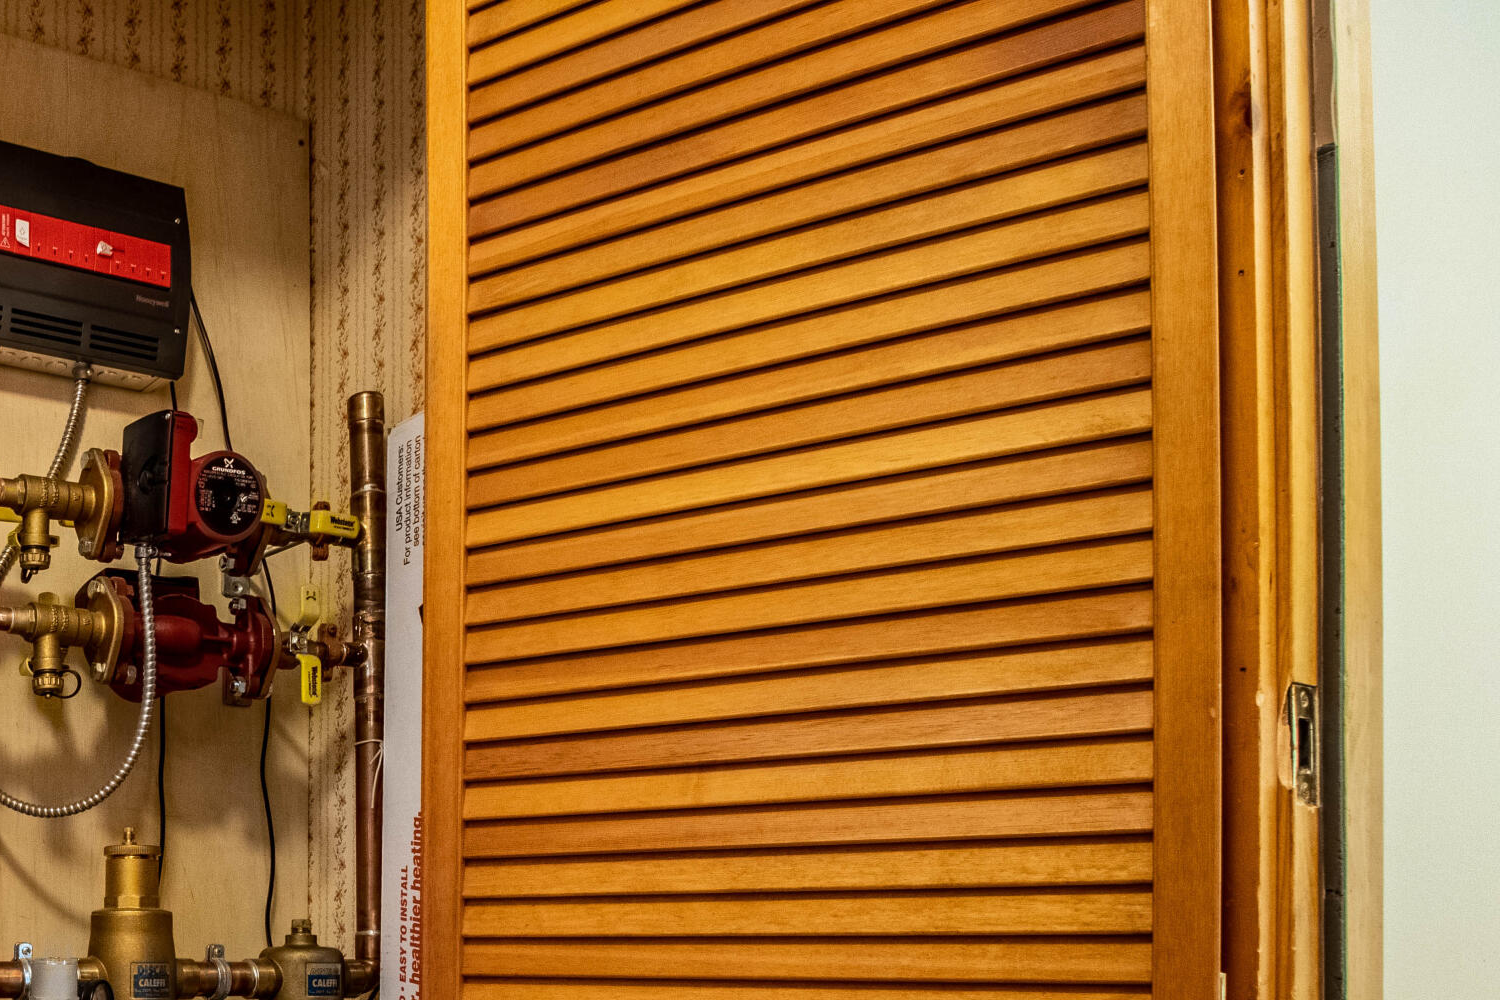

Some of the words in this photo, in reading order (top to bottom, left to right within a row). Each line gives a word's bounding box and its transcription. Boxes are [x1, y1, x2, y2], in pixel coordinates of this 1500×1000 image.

[404, 439, 412, 501] information
[413, 435, 421, 470] carton
[212, 466, 246, 475] GRUNDFOS
[396, 444, 404, 505] Customers:
[413, 474, 420, 485] of
[395, 506, 403, 532] USA
[404, 503, 412, 543] product
[403, 548, 411, 566] For
[400, 865, 408, 922] INSTALL
[400, 925, 407, 943] TO
[409, 896, 421, 985] healthier
[399, 948, 407, 983] EASY
